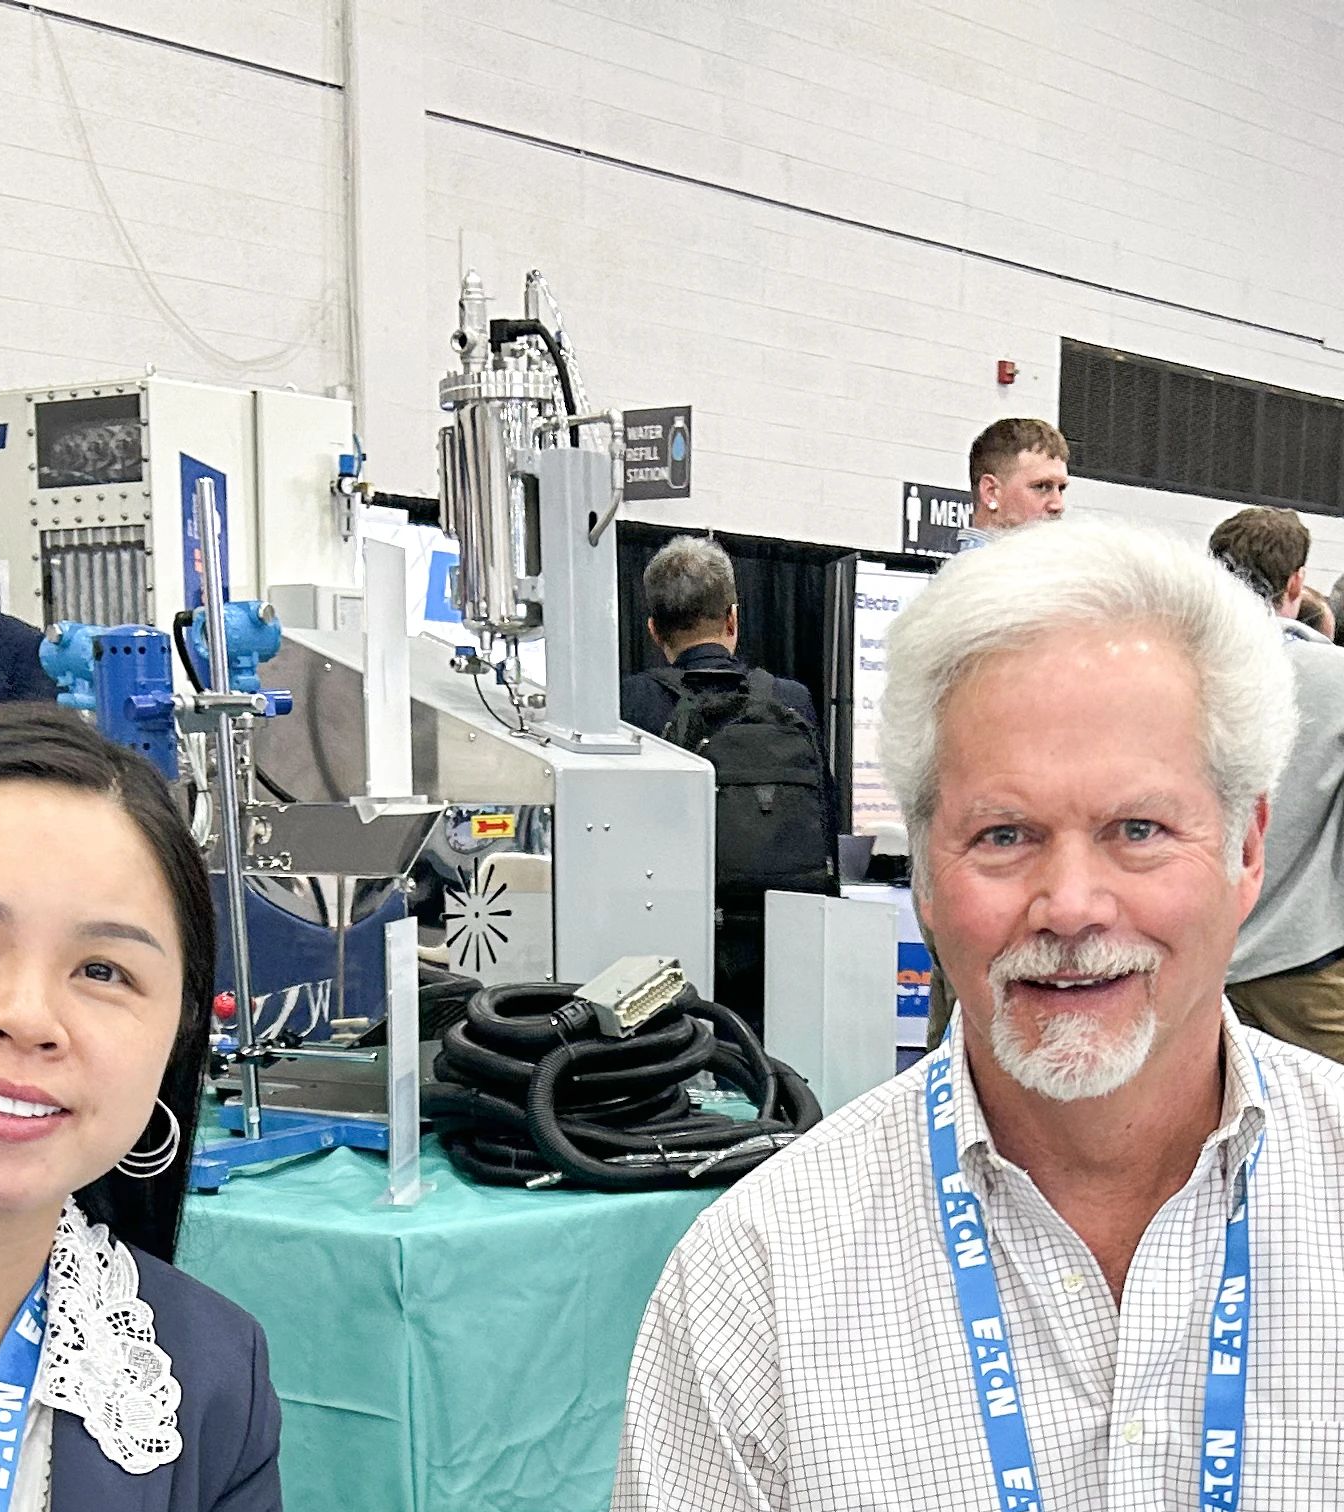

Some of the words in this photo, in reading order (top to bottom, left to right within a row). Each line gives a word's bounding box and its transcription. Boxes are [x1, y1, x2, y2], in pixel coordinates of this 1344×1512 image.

[930, 498, 974, 528] MEN'
[942, 1171, 987, 1269] EATON
[971, 1316, 1018, 1419] EATON
[1212, 1275, 1247, 1377] EATON
